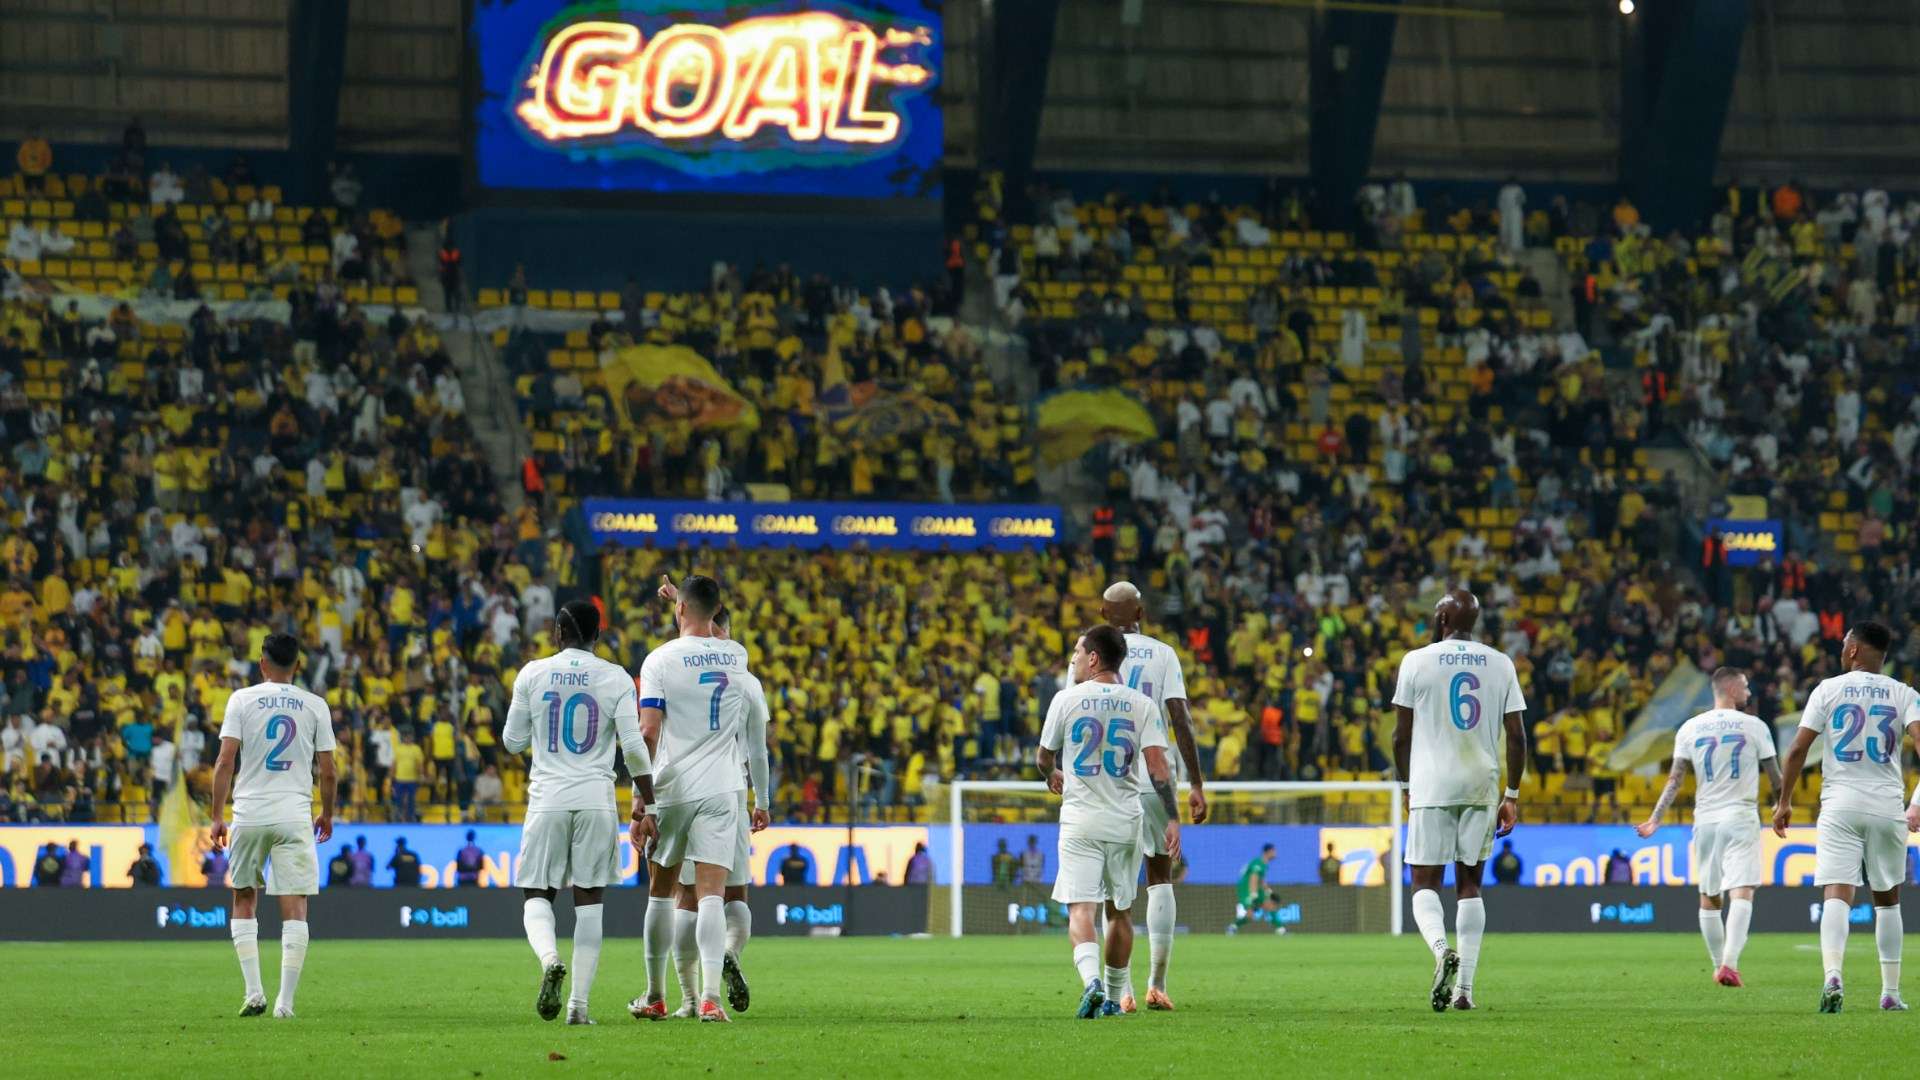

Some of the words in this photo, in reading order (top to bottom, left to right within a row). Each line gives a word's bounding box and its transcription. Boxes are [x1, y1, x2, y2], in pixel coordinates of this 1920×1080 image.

[536, 20, 900, 143] GOAL
[550, 671, 590, 686] MANÉ
[683, 647, 738, 668] RONALDO
[1439, 653, 1487, 667] FOFANA
[257, 696, 304, 711] SULTAN
[698, 671, 730, 731] 7
[1449, 671, 1482, 731] 6
[1844, 686, 1890, 699] AYMAN
[265, 714, 297, 771] 2
[542, 690, 600, 755] 10
[1071, 716, 1136, 778] 25
[1832, 703, 1898, 764] 23
[1695, 733, 1747, 782] 77
